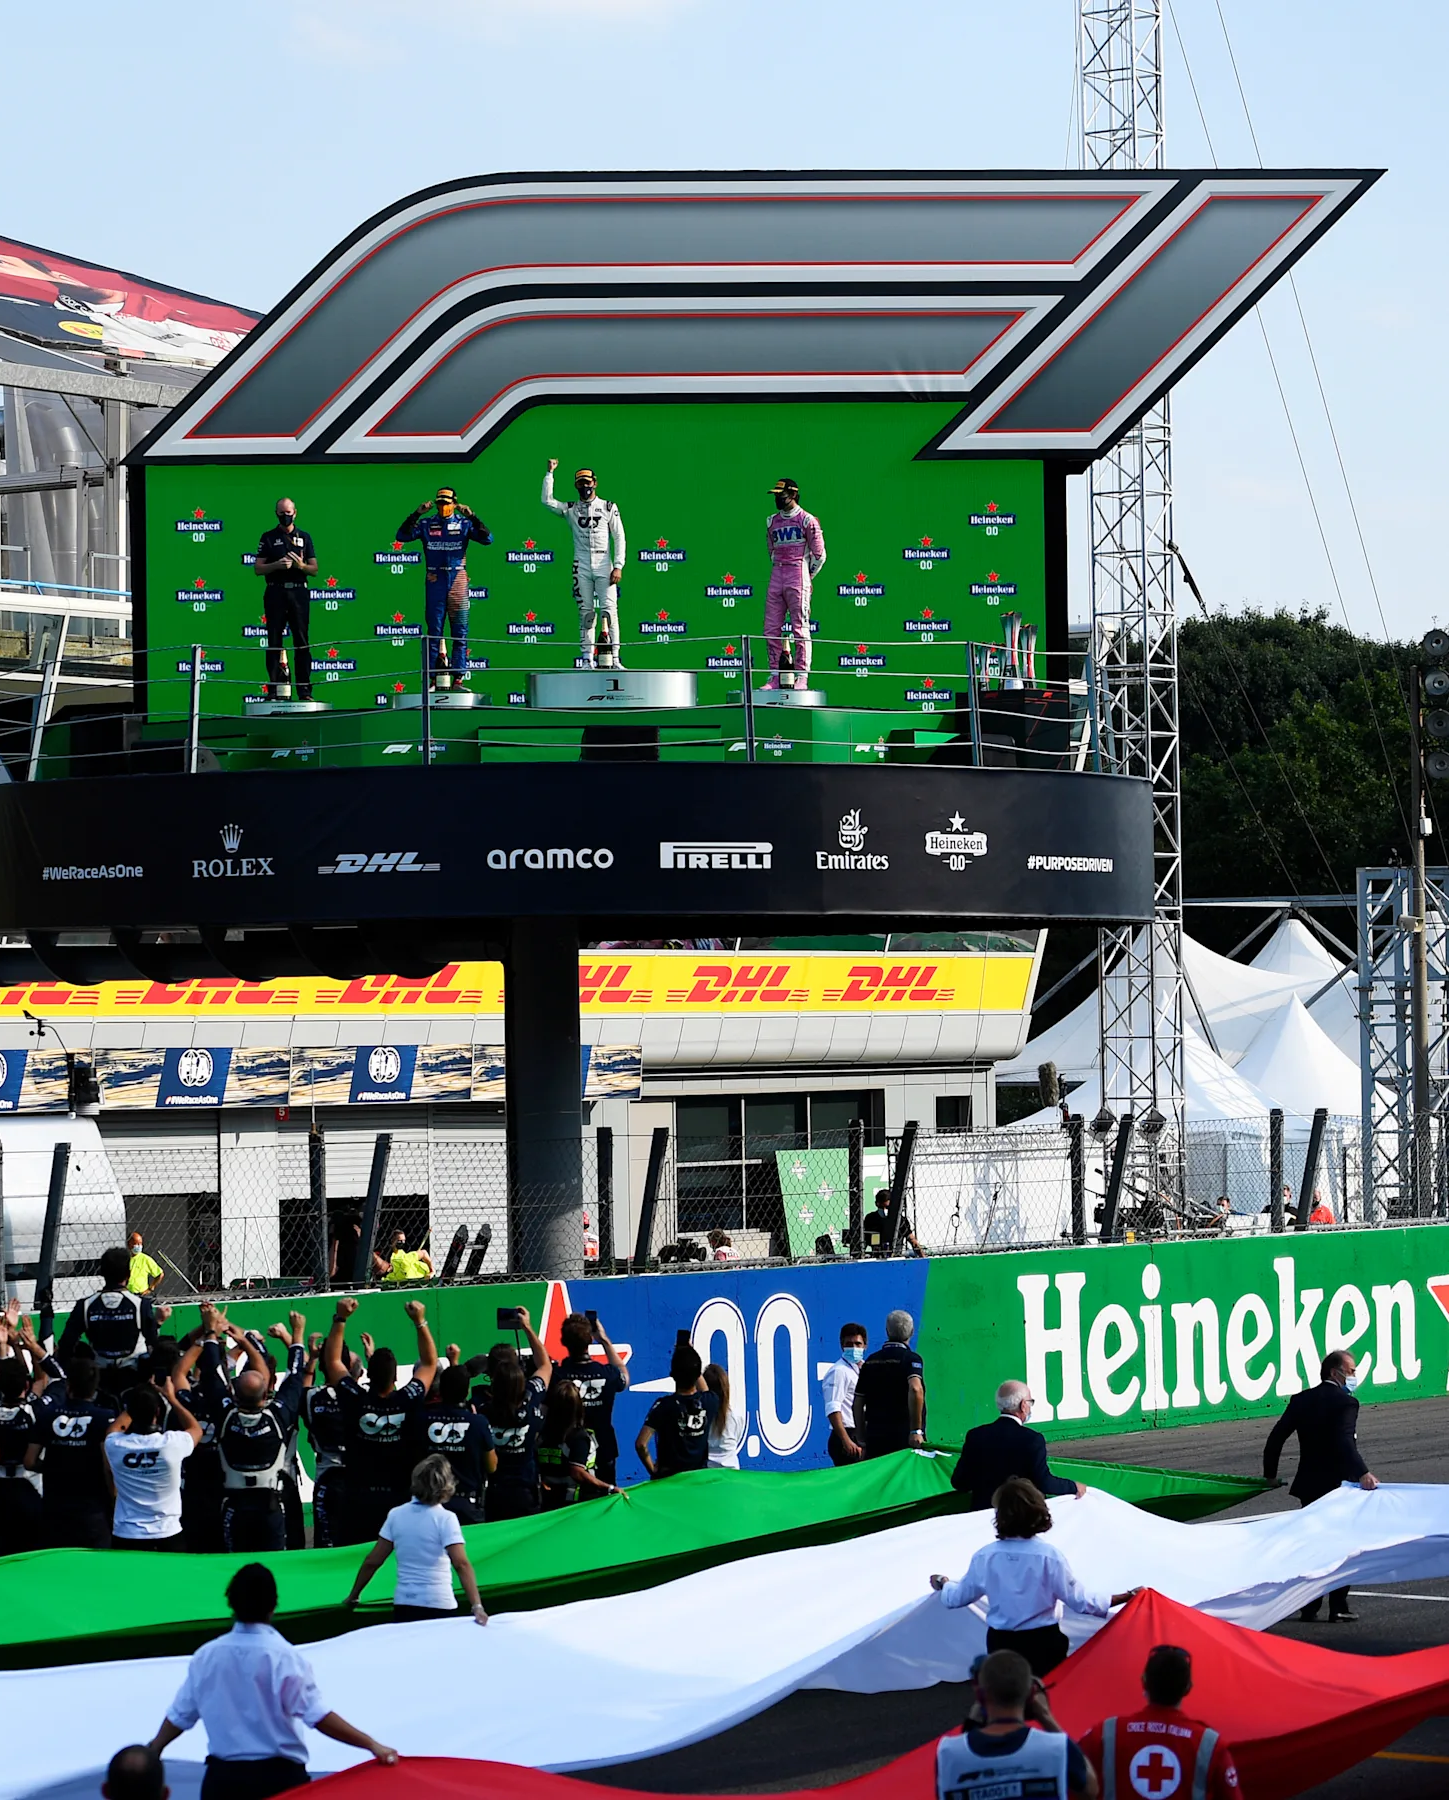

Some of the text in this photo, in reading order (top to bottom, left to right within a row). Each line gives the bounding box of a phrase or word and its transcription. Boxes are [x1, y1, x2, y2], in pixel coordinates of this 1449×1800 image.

[971, 515, 1014, 524] Heineken
[177, 521, 221, 530] Heineken
[375, 553, 419, 563] Heineken
[508, 552, 551, 562] Heineken
[640, 551, 683, 560] Heineken
[904, 549, 948, 558] Heineken
[310, 589, 354, 599] Heineken
[706, 587, 750, 597] Heineken
[839, 585, 883, 595] Heineken
[971, 584, 1015, 594] Heineken
[178, 590, 222, 600] Heineken
[377, 625, 420, 635] Heineken
[509, 624, 552, 633] Heineken
[641, 623, 684, 633] Heineken
[905, 621, 949, 631] Heineken
[311, 661, 354, 671] Heineken
[708, 658, 744, 667] Heinek
[840, 656, 884, 666] Heineken
[178, 662, 222, 671] Heeken
[906, 690, 950, 700] Heineken
[930, 836, 983, 851] Heineken
[487, 848, 614, 869] aramco
[660, 842, 773, 869] PIRELLI
[816, 851, 889, 870] Emirates
[192, 857, 275, 878] ROLEX
[332, 852, 424, 873] DHL
[1027, 854, 1113, 873] #PURPOSEDRIVEN
[42, 863, 143, 880] #WeRaceAsOne
[579, 965, 632, 1003] HL
[685, 966, 792, 1003] DHL
[840, 966, 938, 1001] DHL
[1017, 1256, 1421, 1425] Heineken
